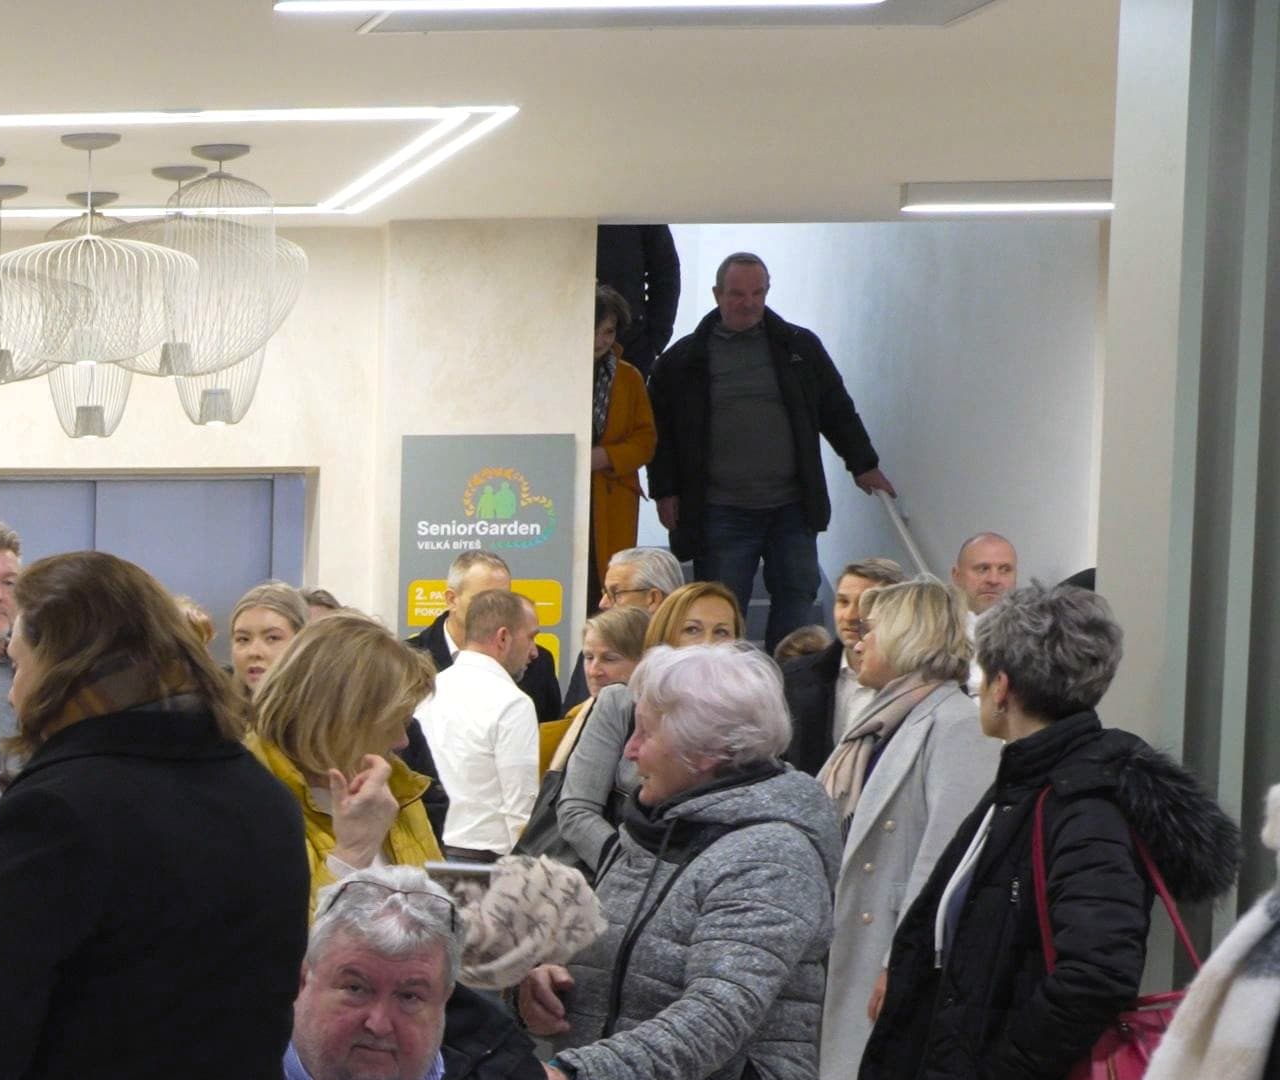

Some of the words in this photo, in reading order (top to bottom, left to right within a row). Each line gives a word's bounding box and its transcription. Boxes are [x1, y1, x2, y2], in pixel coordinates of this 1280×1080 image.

[417, 520, 541, 536] SeniorGarden
[417, 540, 450, 550] VELKÁ
[452, 539, 481, 550] BÍTEŠ
